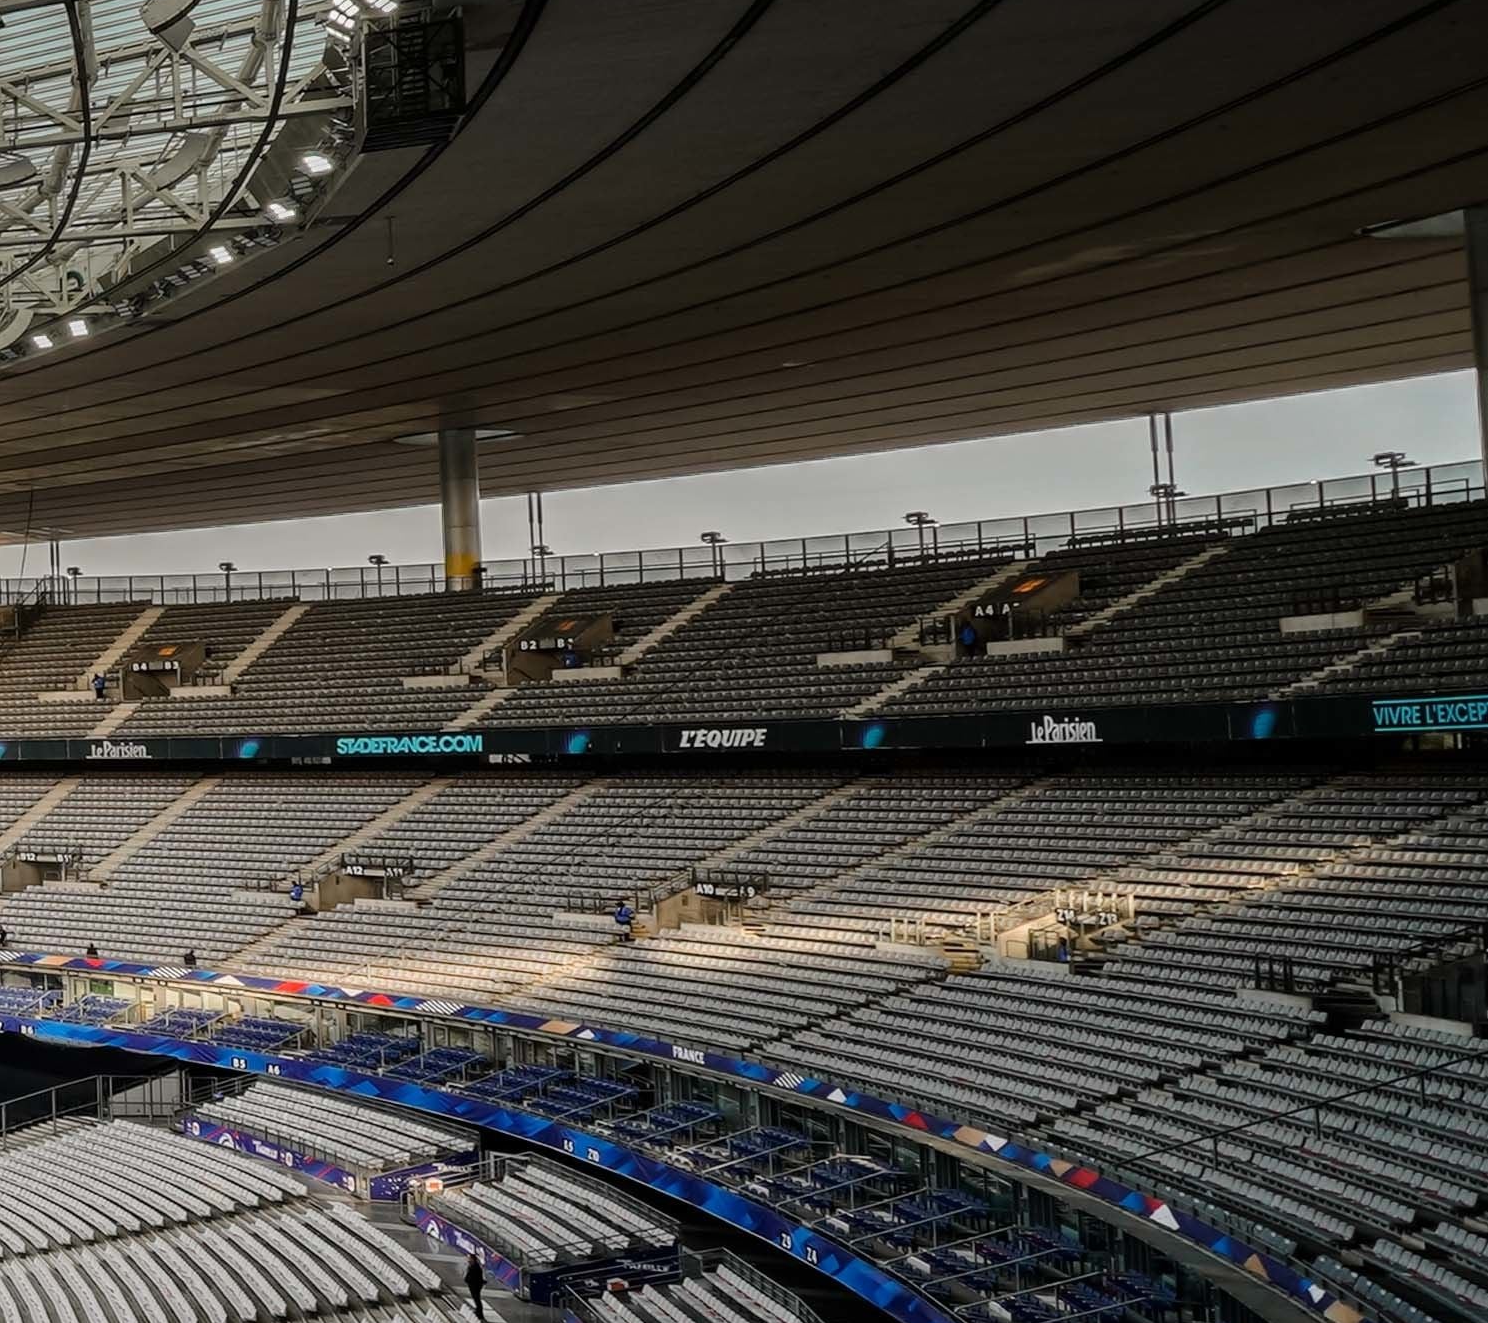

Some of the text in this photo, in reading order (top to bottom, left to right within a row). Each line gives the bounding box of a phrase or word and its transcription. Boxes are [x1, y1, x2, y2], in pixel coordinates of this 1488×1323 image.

[520, 640, 537, 650] B2
[132, 663, 147, 671] B4
[1372, 701, 1488, 726] VIVRE L'EXCEP
[1044, 714, 1096, 741] Parisien
[102, 740, 147, 758] Parisien
[336, 733, 483, 756] STADEFRANCE.COM
[345, 865, 363, 876] A12
[696, 883, 714, 895] A10
[671, 1044, 705, 1066] FRANCE
[232, 1057, 281, 1076] B5 A6
